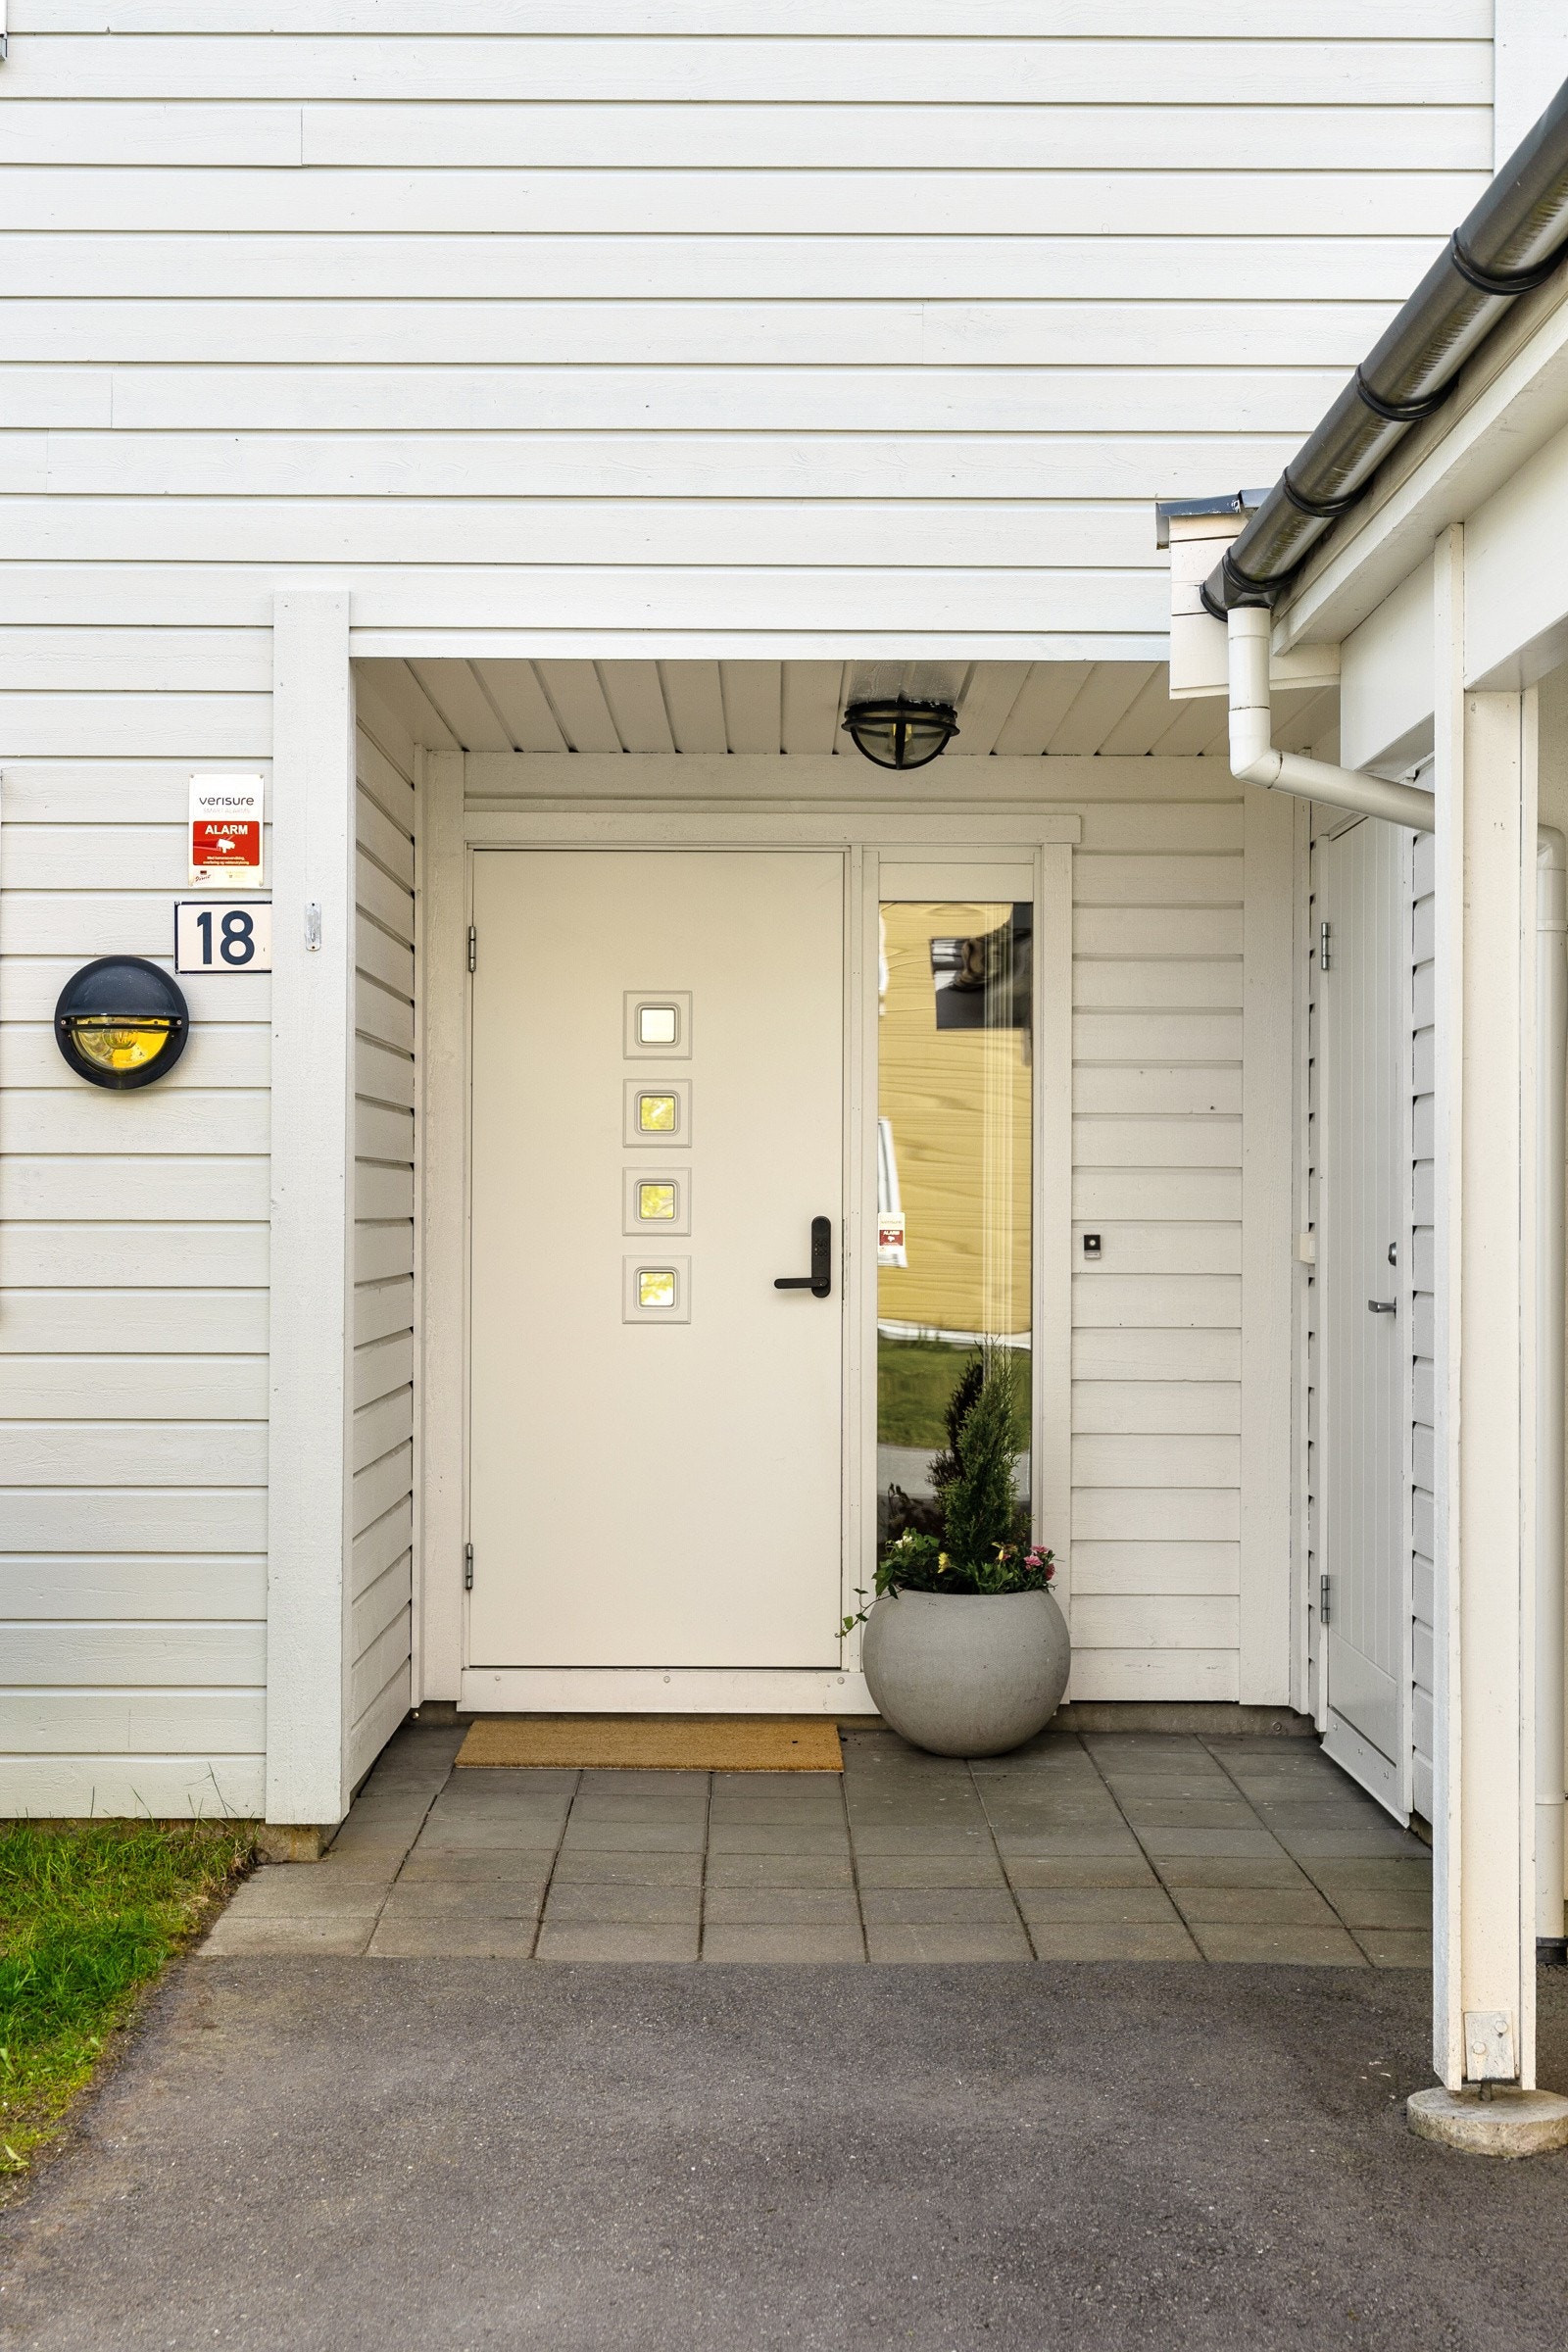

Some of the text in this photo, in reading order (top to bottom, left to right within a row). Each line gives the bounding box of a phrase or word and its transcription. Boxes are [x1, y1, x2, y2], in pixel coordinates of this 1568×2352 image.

[199, 797, 254, 806] verisure
[205, 824, 248, 835] ALARM
[197, 909, 255, 966] 18
